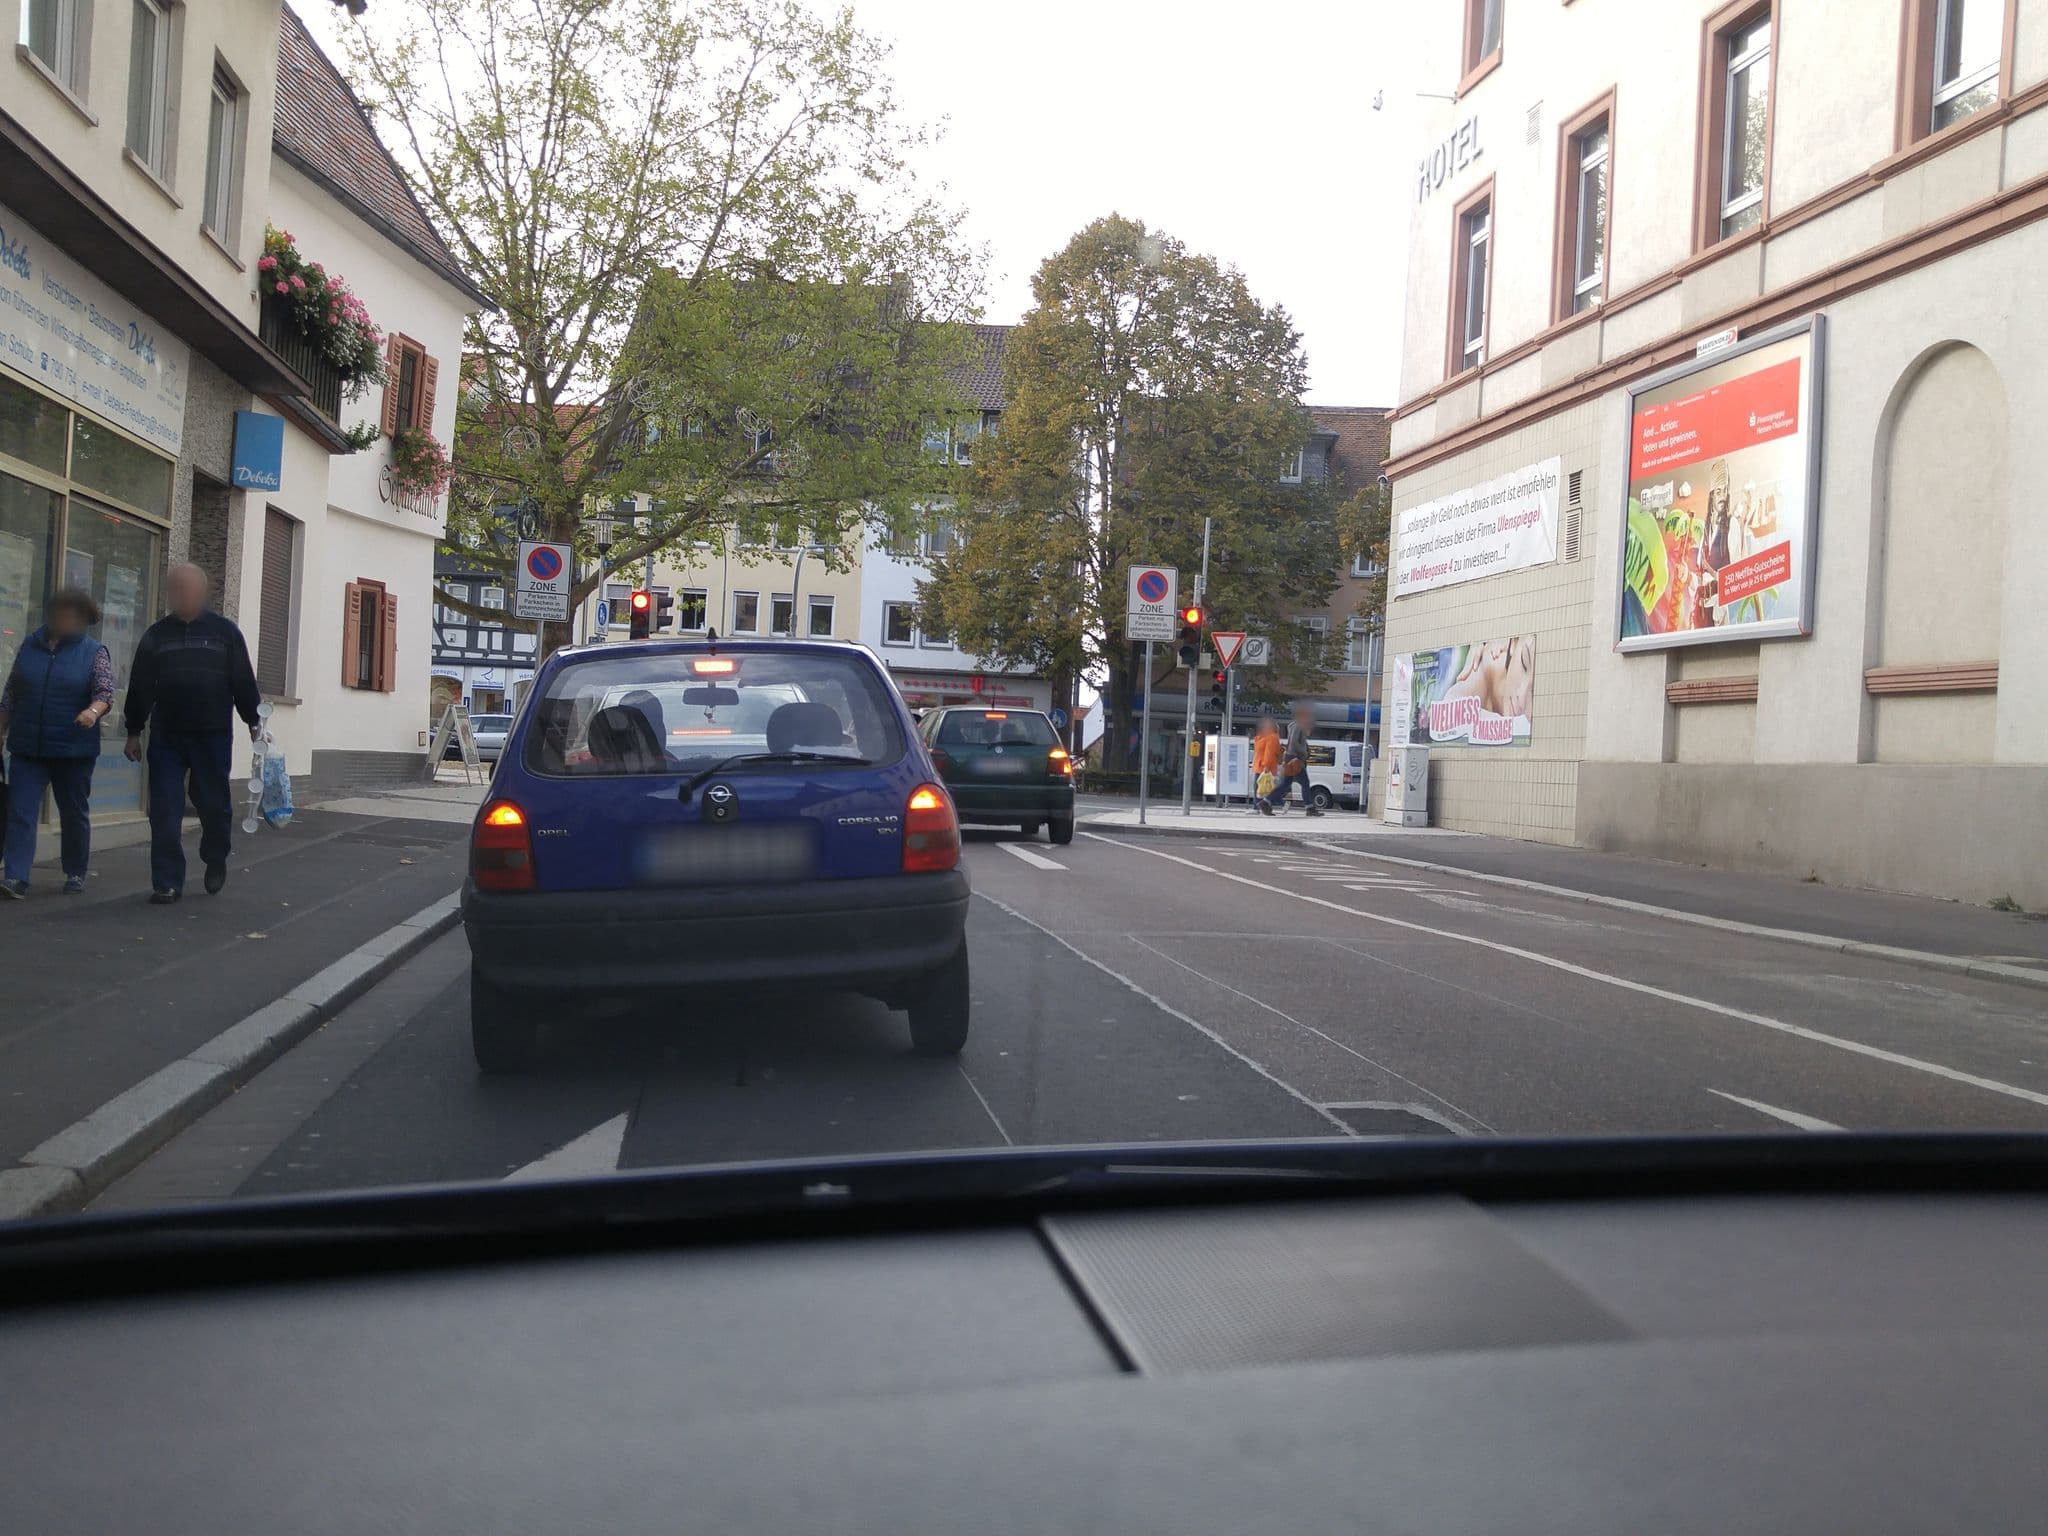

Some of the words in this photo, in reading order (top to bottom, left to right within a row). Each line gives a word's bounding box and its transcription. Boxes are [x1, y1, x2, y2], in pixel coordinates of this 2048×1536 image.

[1418, 114, 1484, 204] HOTEL
[1658, 436, 1669, 449] und
[234, 465, 278, 486] Debeka
[1439, 504, 1453, 523] Geld
[1453, 499, 1470, 518] noch
[1470, 495, 1490, 513] etwas
[1490, 490, 1507, 507] wert
[1516, 471, 1557, 499] empfehlen
[1405, 536, 1434, 559] dringend
[1434, 534, 1453, 550] dieses
[1454, 527, 1465, 545] bei
[1465, 524, 1477, 541] der
[1477, 521, 1496, 539] Firma
[1496, 503, 1541, 533] Ulenspiegel
[1448, 558, 1454, 573] 4
[1454, 559, 1462, 572] zu
[1724, 572, 1735, 586] 250
[1753, 574, 1760, 585] 25
[529, 581, 557, 592] ZONE
[1139, 603, 1164, 614] ZONE
[1249, 642, 1260, 654] 30
[1431, 697, 1481, 733] WELLNESS
[1477, 718, 1513, 741] MASSAGE
[537, 829, 568, 838] OPEL
